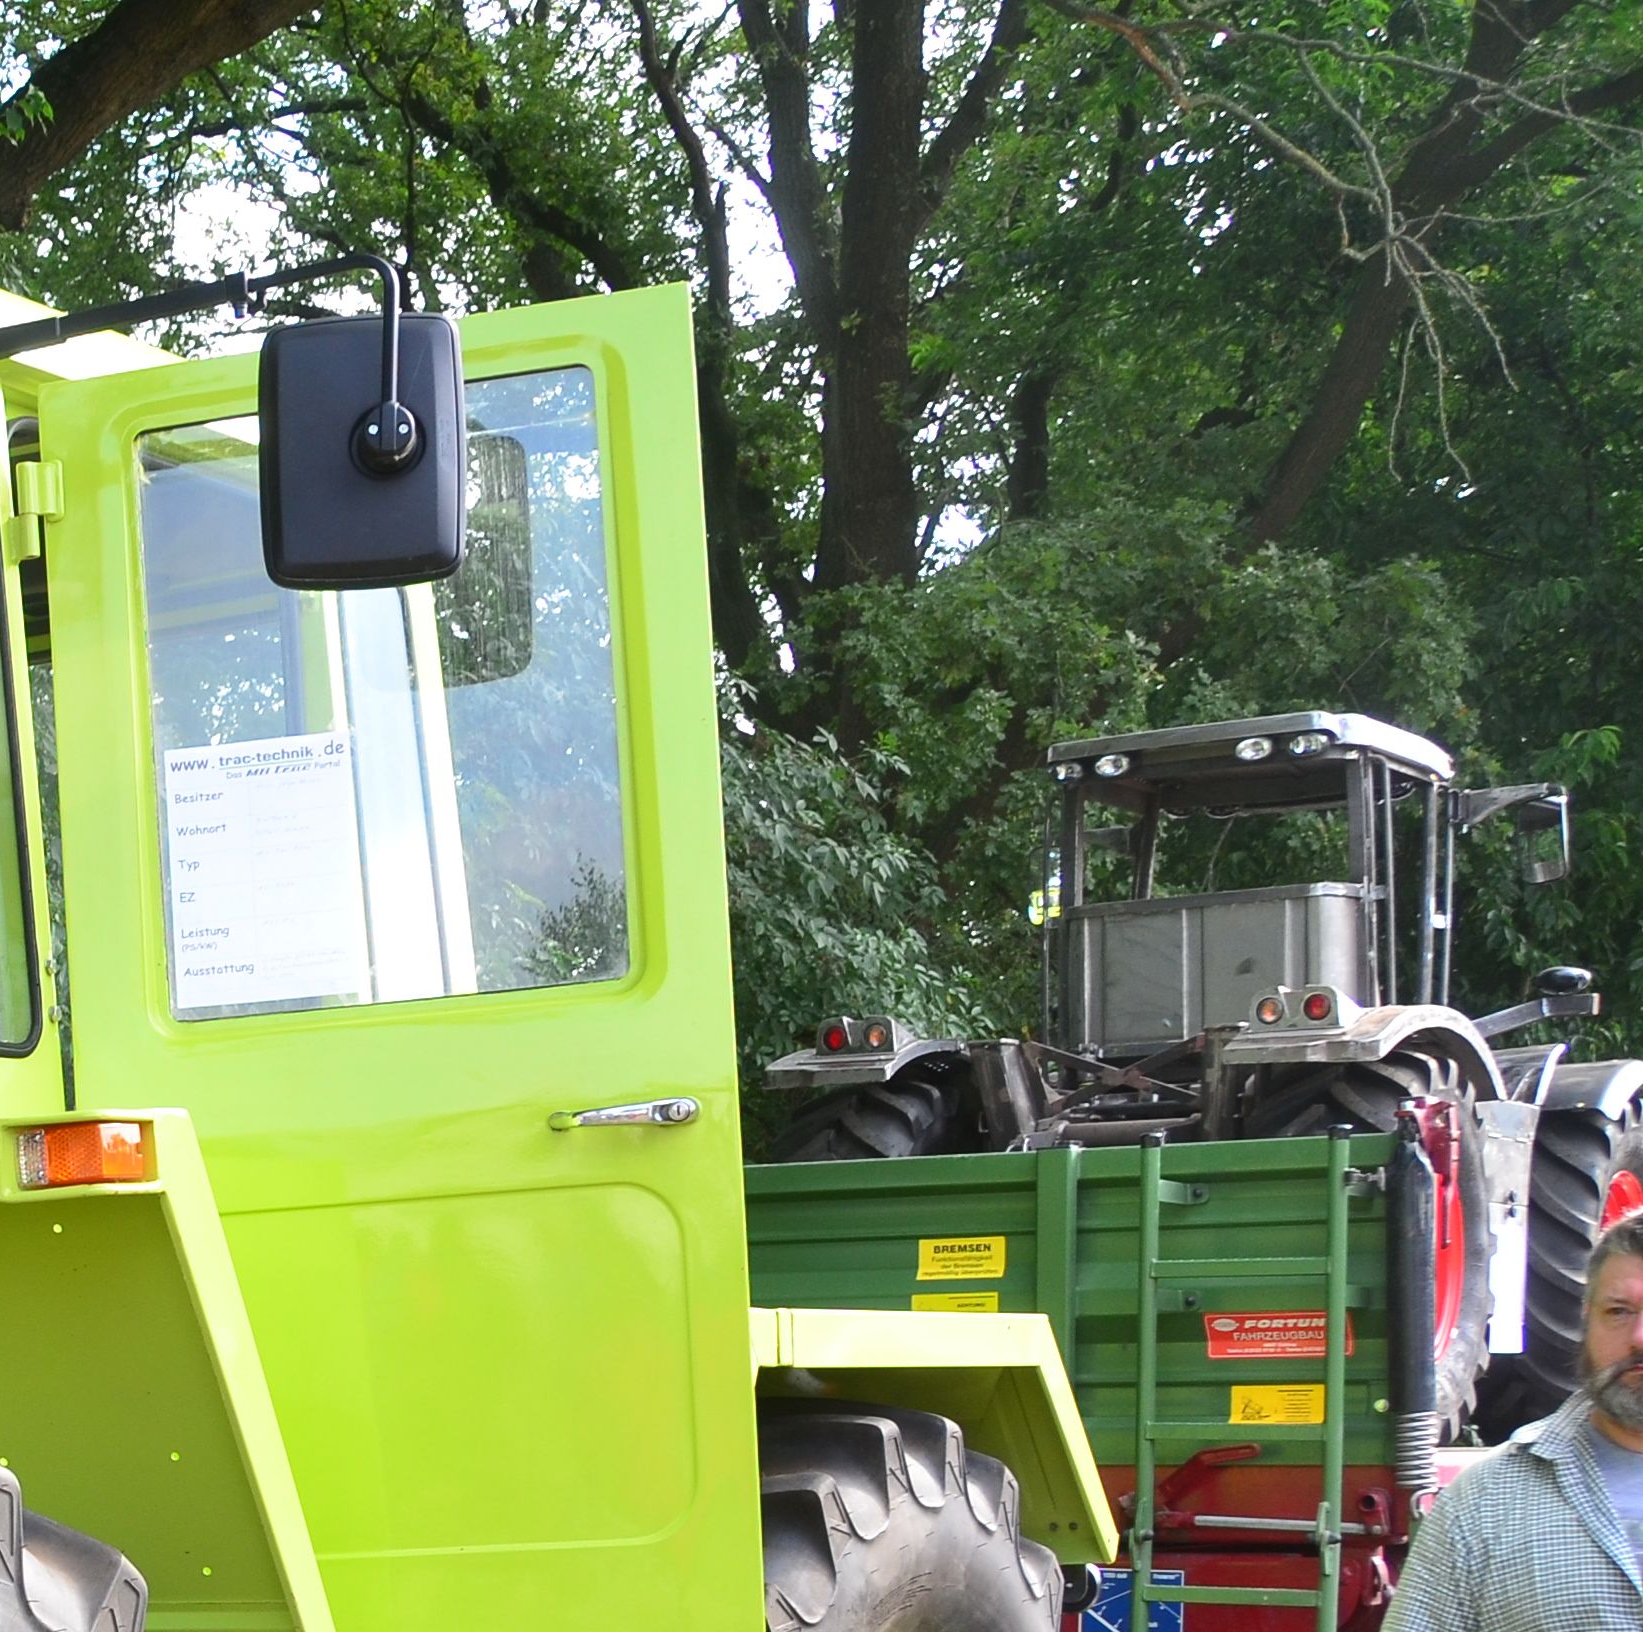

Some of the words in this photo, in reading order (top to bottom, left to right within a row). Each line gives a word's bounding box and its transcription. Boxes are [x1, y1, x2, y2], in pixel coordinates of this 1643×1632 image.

[174, 790, 224, 805] Besitzer
[175, 823, 227, 837] Wohnort
[178, 859, 200, 871] Typ
[179, 892, 196, 903] EZ
[180, 925, 230, 940] Leistung
[183, 961, 255, 977] Ausstattung
[933, 1243, 992, 1254] BREMSEN
[1244, 1318, 1326, 1329] FORTUN
[1233, 1331, 1325, 1341] FAHRZEUGBAU
